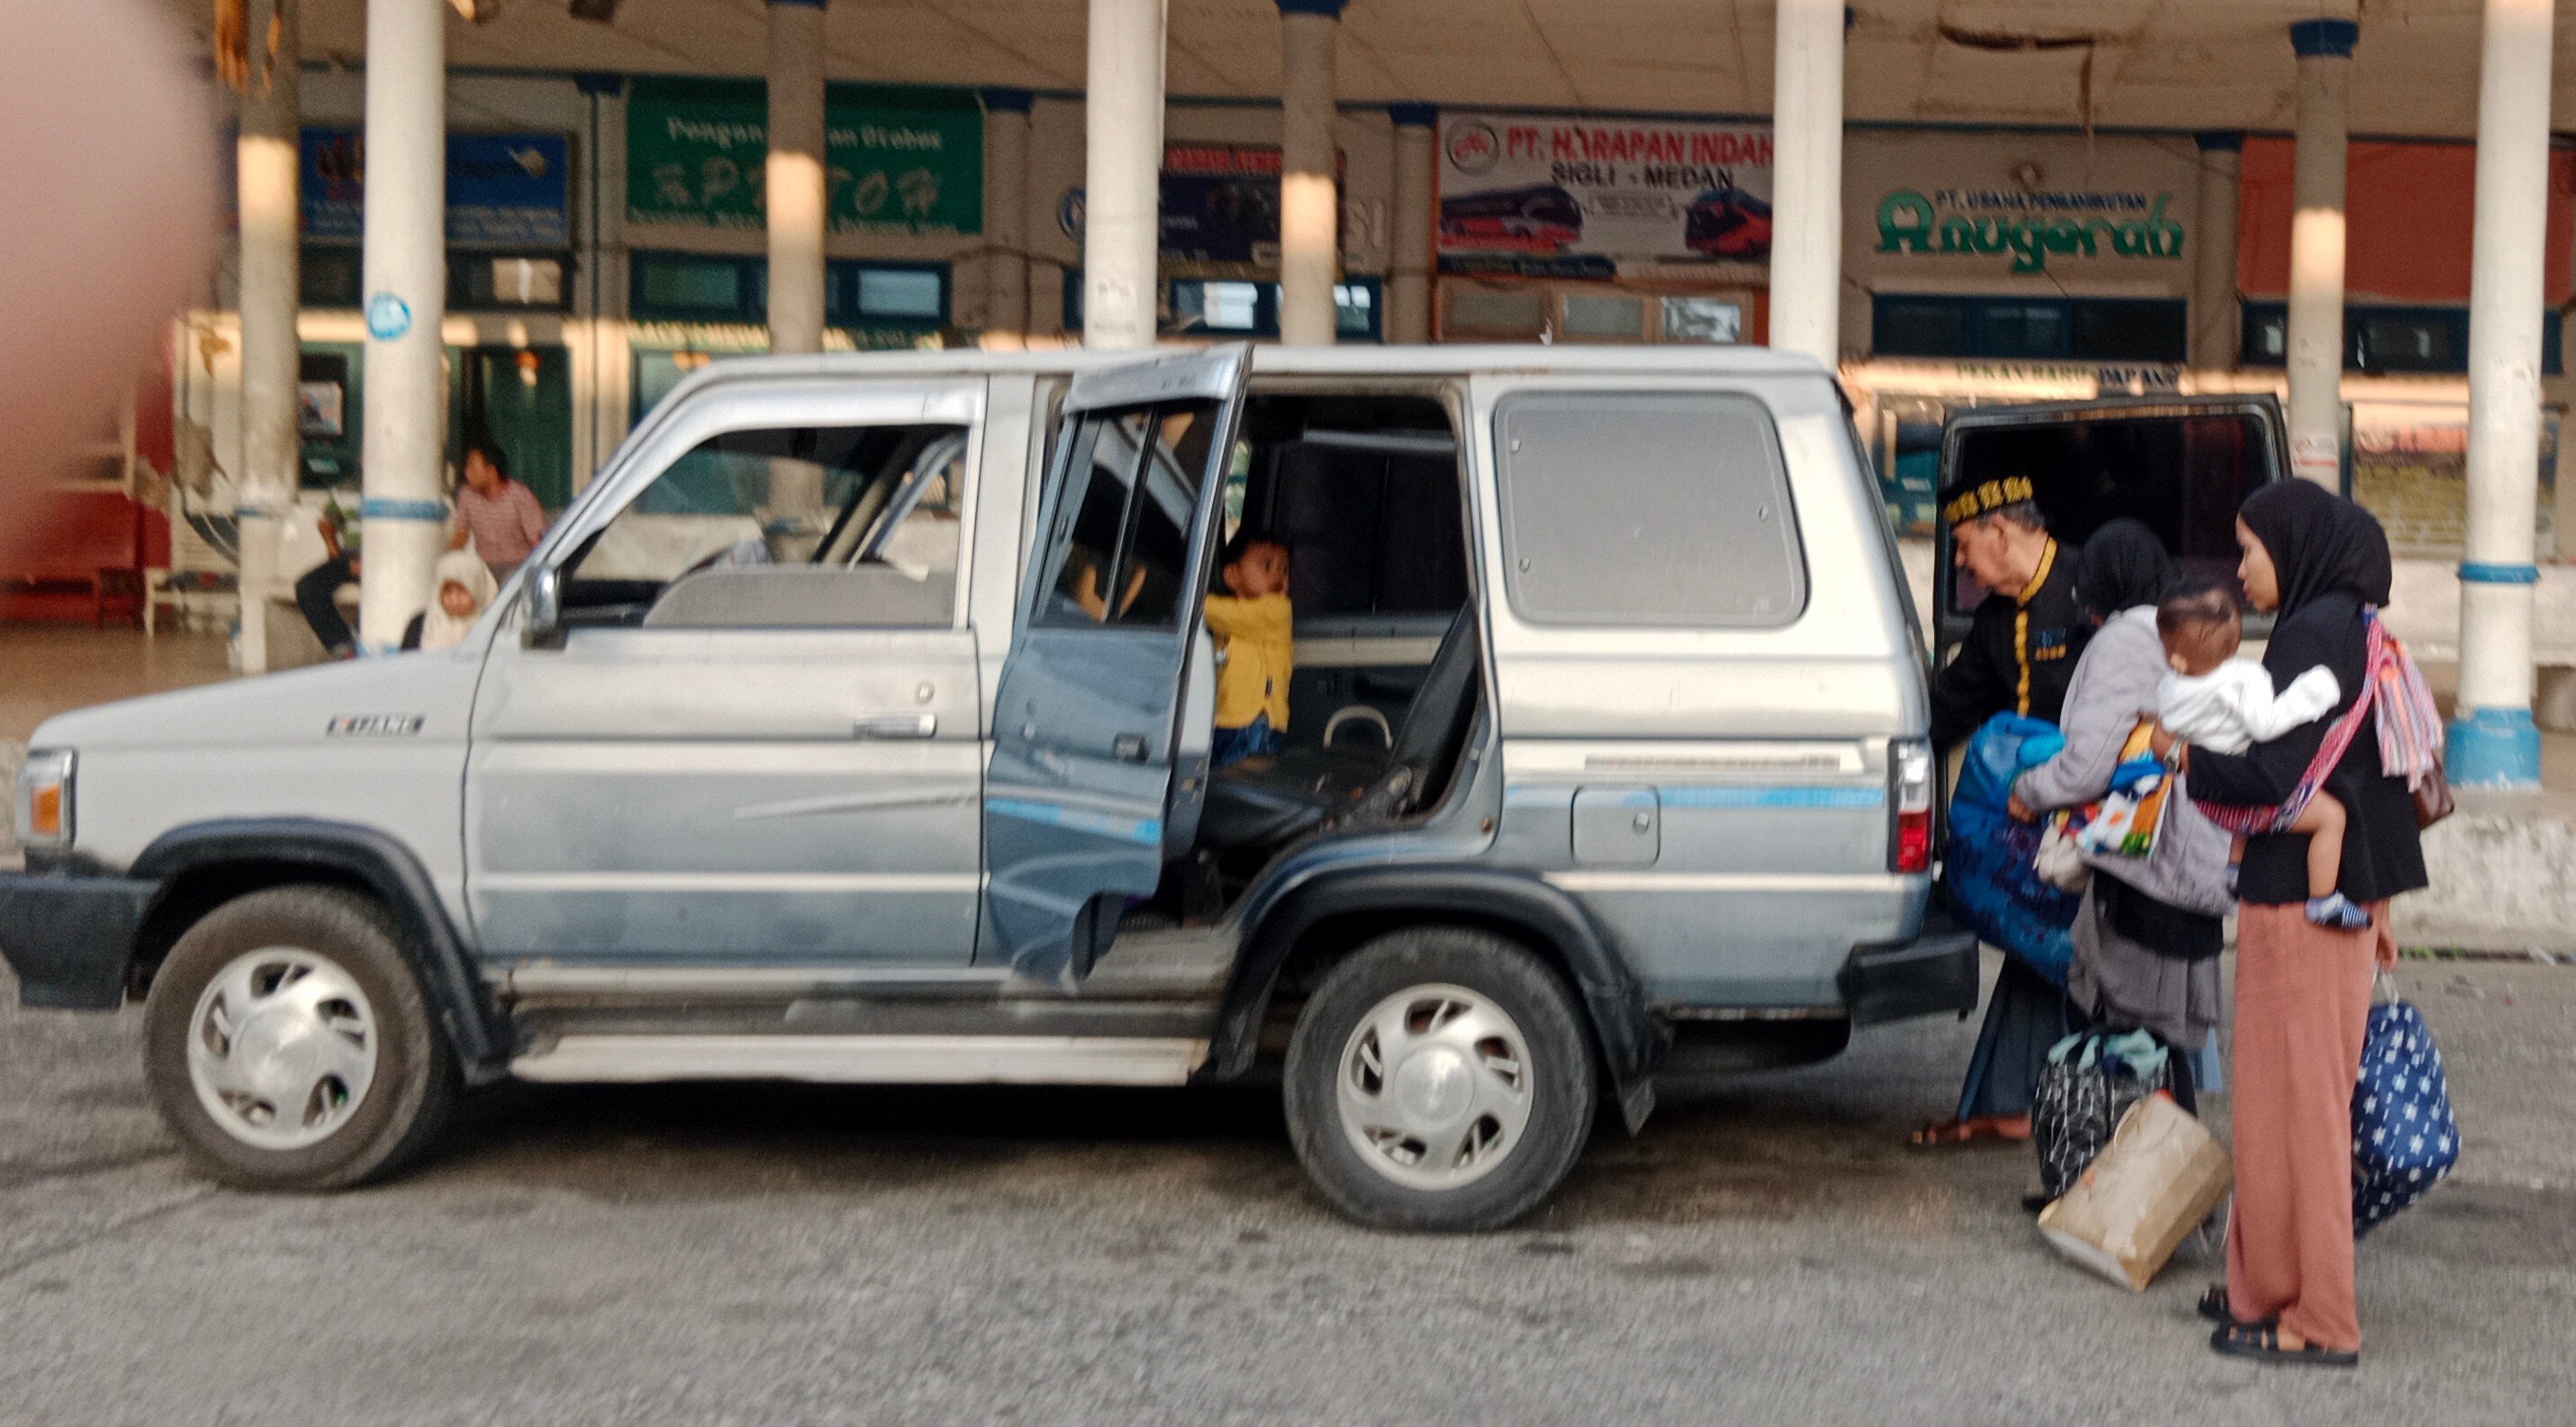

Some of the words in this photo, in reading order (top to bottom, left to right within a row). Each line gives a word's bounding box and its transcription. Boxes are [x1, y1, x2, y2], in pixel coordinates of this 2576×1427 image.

[1506, 125, 1547, 161] PT.
[1551, 161, 1616, 188] SIGLI
[1644, 164, 1734, 191] MEDAN
